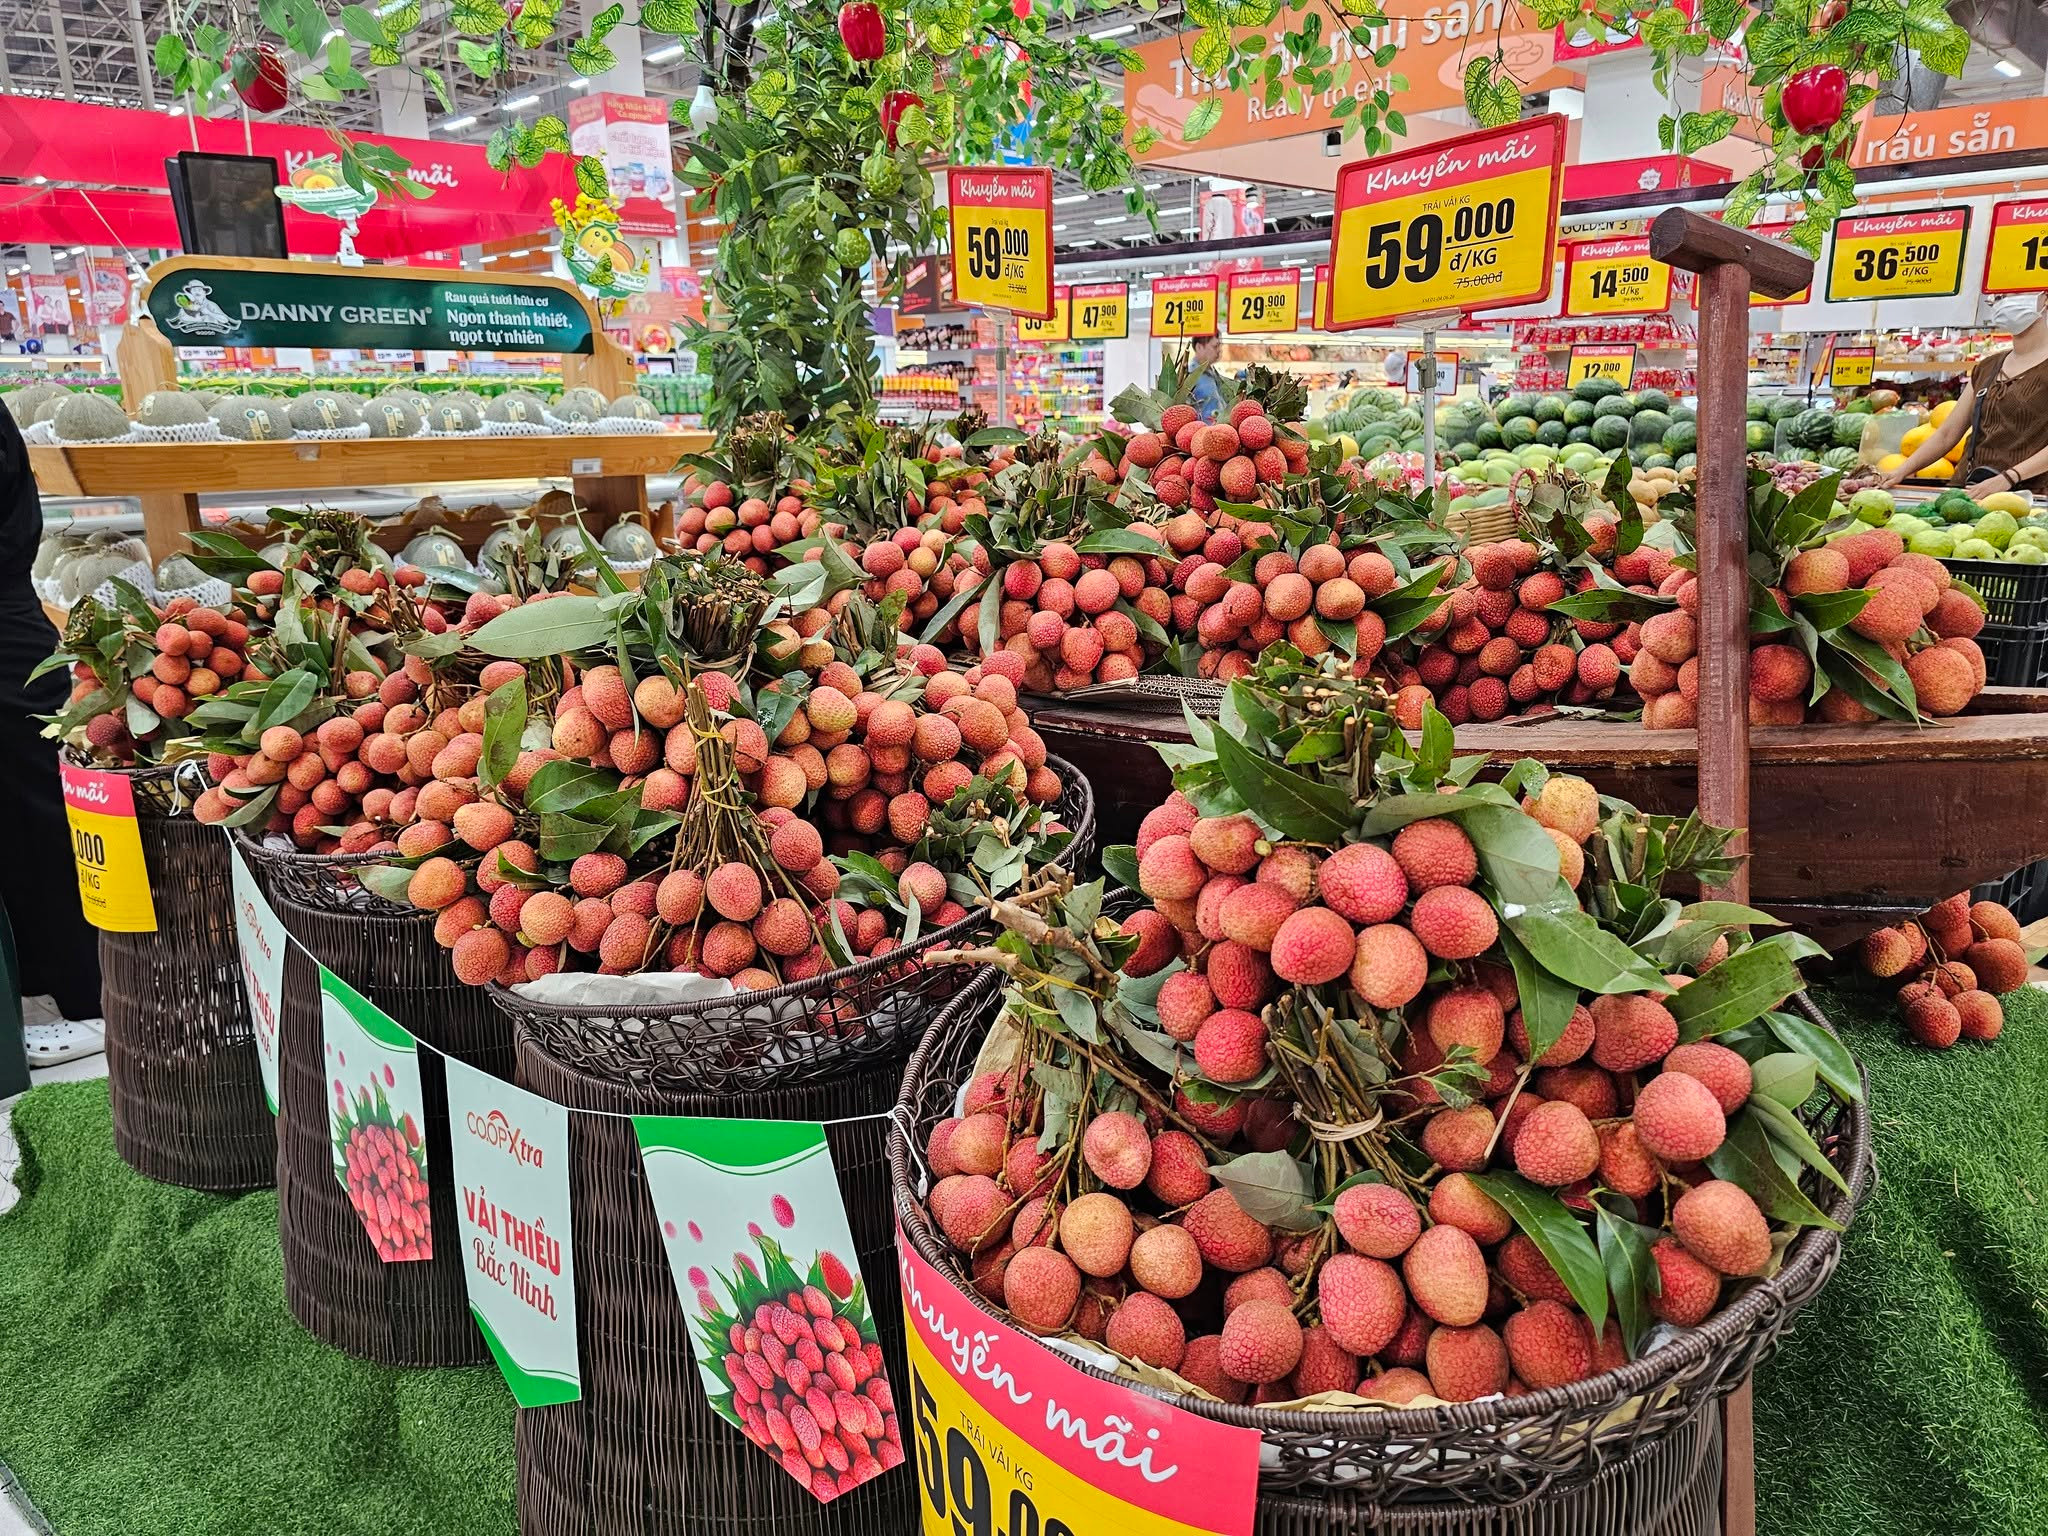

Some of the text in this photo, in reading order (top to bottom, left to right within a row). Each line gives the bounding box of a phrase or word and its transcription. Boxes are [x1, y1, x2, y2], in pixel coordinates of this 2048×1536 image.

[1354, 71, 1394, 102] eat
[1865, 111, 2016, 164] nấu sẵn
[407, 163, 459, 188] mãi
[1366, 135, 1537, 194] Khuyến mãi
[960, 175, 1036, 202] Khuyến mãi
[1423, 198, 1441, 212] TRÁI
[1458, 195, 1471, 205] KG
[1853, 213, 1957, 233] Khuyến mãi
[967, 227, 1029, 280] 59.000
[1365, 197, 1516, 290] 59.000
[1581, 241, 1631, 257] Khuyến
[1004, 263, 1024, 279] đ/KG
[1449, 248, 1498, 273] đ/KG
[1853, 244, 1940, 282] 36.500
[1902, 266, 1929, 277] đ/KG
[1454, 271, 1503, 289] 75.000đ
[1590, 267, 1649, 299] 14.500
[1620, 286, 1640, 295] đ/kg
[444, 291, 467, 303] Rau
[468, 293, 490, 306] quả
[491, 293, 512, 305] tươi
[535, 296, 549, 307] cơ
[1242, 294, 1285, 321] 29.900
[239, 302, 334, 323] DANNY
[446, 309, 573, 329] Ngon thanh khiết,
[1165, 300, 1204, 325] 21.900
[449, 329, 544, 346] ngọt tự nhiên
[76, 782, 110, 804] mãi
[463, 1185, 561, 1277] VẢI THIỀU
[473, 1237, 558, 1322] Bắc Ninh
[900, 1248, 1178, 1483] Khuyến mãi
[960, 1410, 1034, 1491] TRÁI VẢI KG
